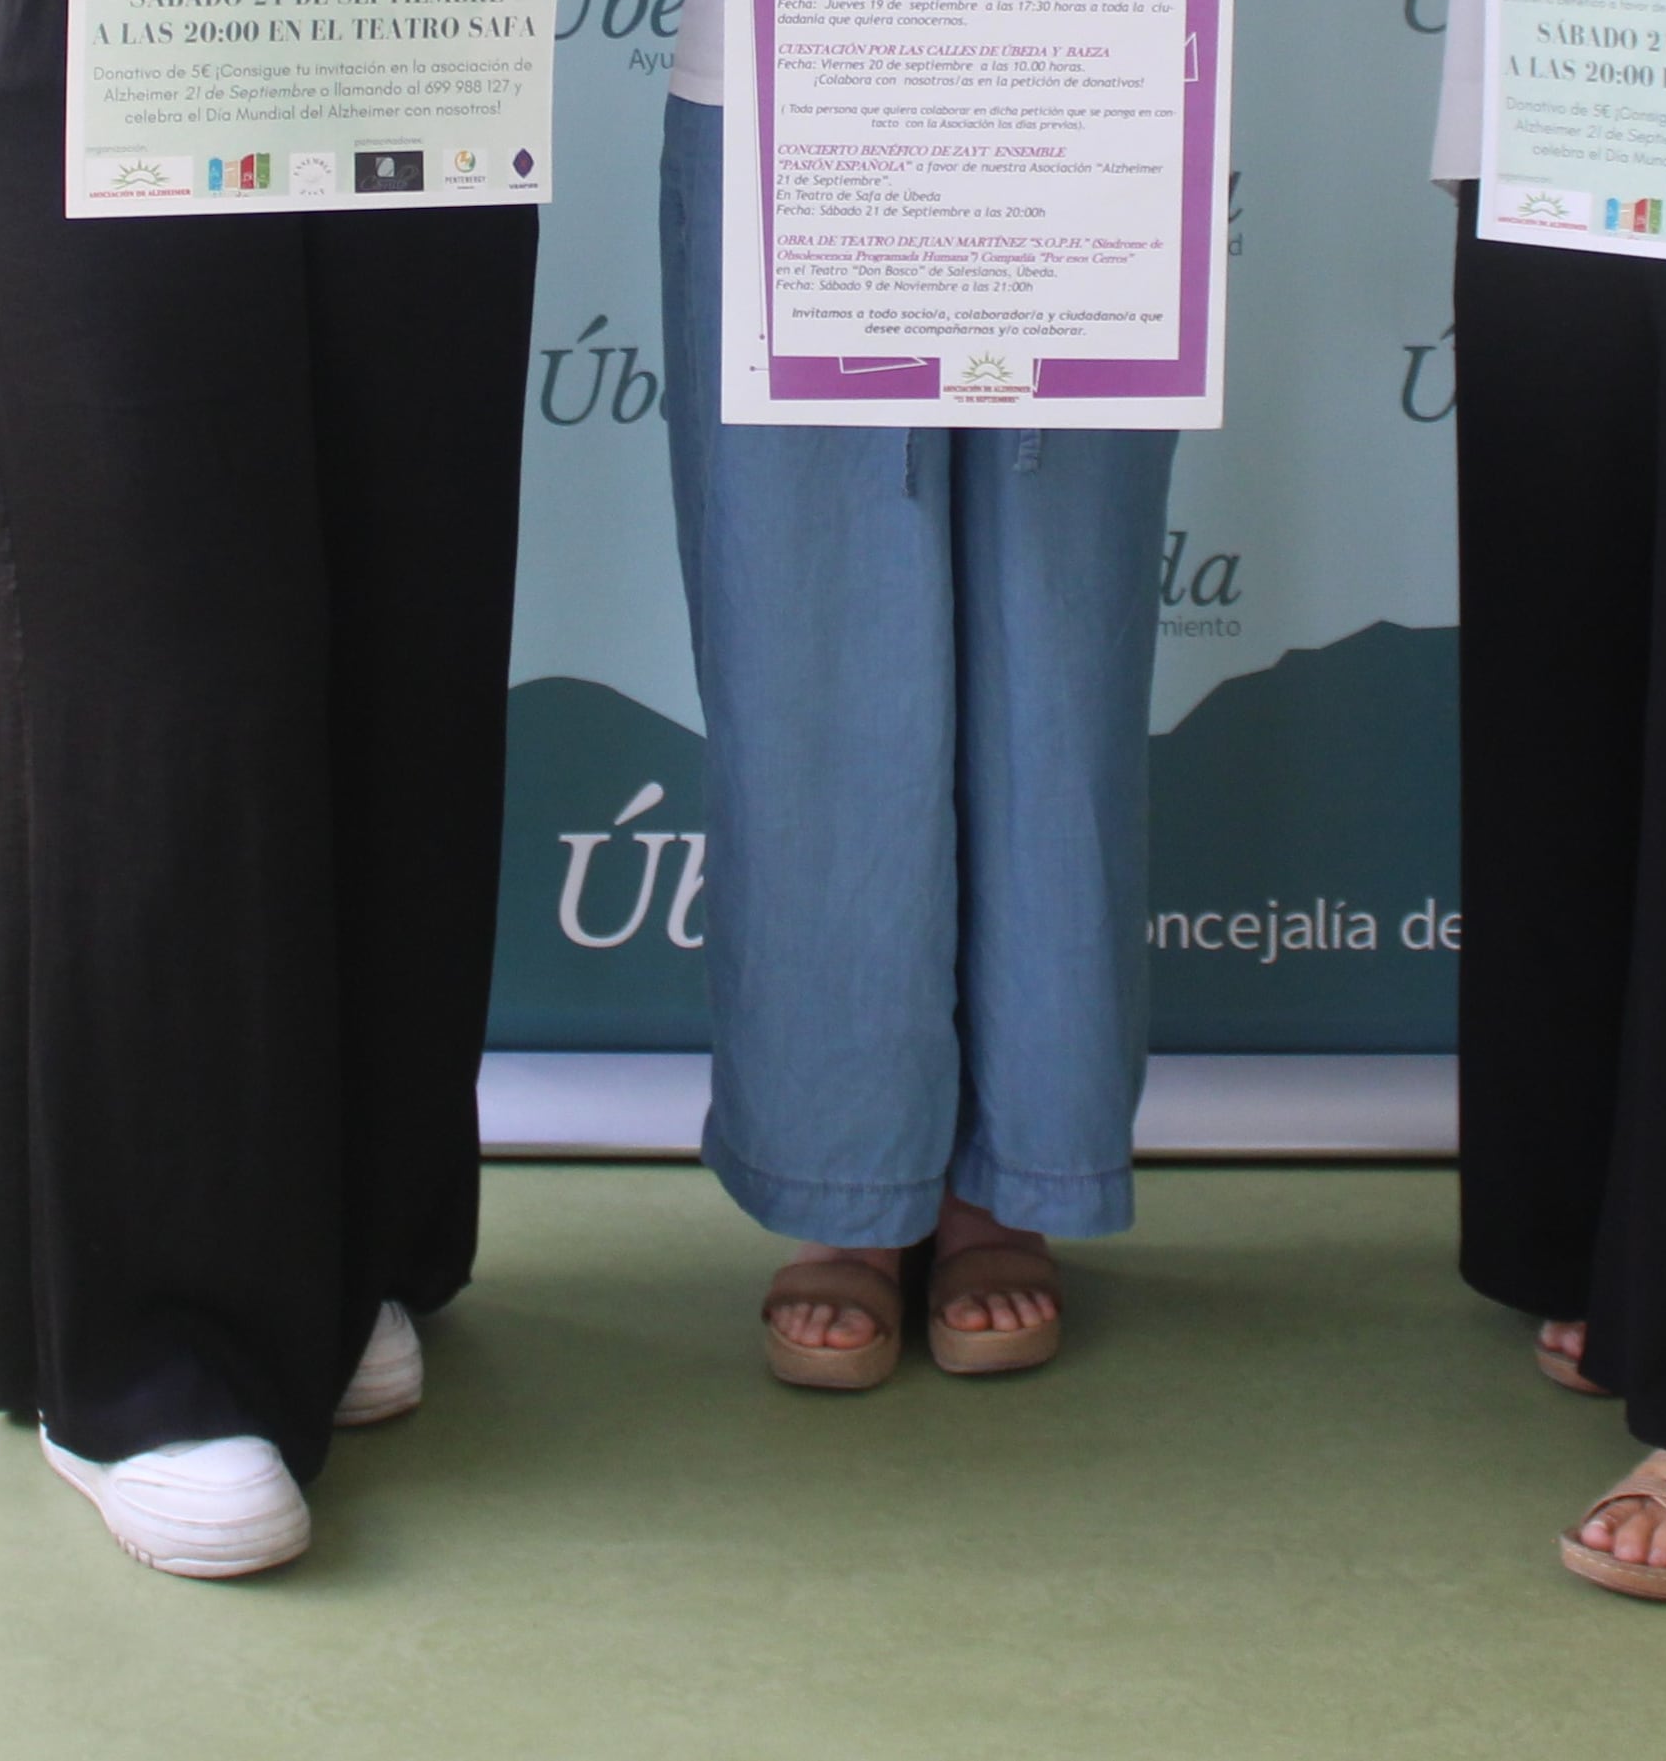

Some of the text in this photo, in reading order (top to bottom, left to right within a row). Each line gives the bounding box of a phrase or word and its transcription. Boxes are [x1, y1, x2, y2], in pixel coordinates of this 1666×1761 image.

[92, 16, 535, 45] A LAS 20:00 EN EL TEATRO SAFA
[1537, 21, 1639, 48] SÁBADO
[93, 56, 533, 81] Donativo de 5€ ¡Consigue tu invitación en la asociación de
[1505, 55, 1520, 76] A
[1530, 56, 1576, 80] LAS
[1585, 61, 1655, 86] 20:00
[103, 78, 522, 104] Alzheimer 21 de Septiembre o llamando al 699 988 127 y
[124, 100, 501, 124] celebra el Día Mundial del Alzheimer con nosotros!
[1146, 896, 1378, 965] ncejalía
